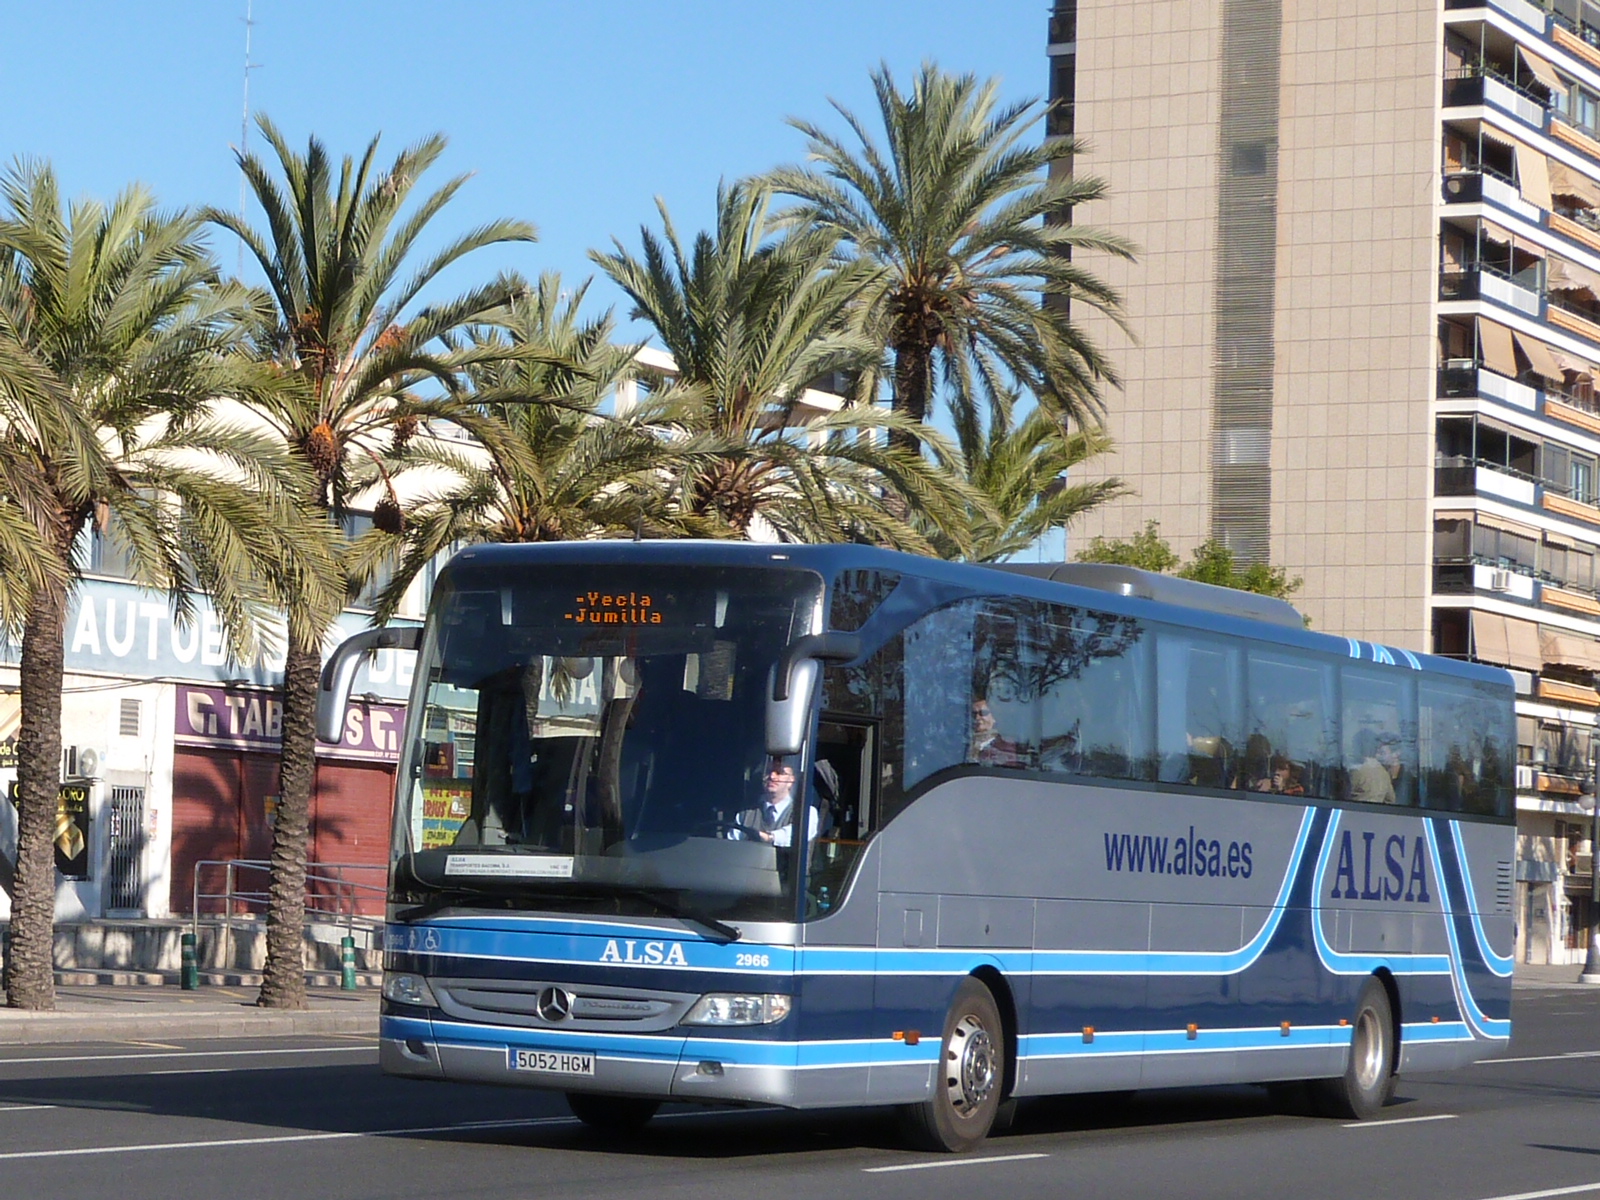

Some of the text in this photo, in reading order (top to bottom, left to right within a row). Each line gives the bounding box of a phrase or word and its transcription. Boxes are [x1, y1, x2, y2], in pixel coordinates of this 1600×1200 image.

[576, 592, 651, 606] -Yecla
[565, 608, 662, 623] -Jumilla
[225, 696, 363, 746] TABS
[1104, 826, 1252, 879] www.alsa.es
[1331, 830, 1430, 903] ALSA
[599, 939, 769, 967] ALSA 2966
[519, 1052, 590, 1072] 5052 HGM
